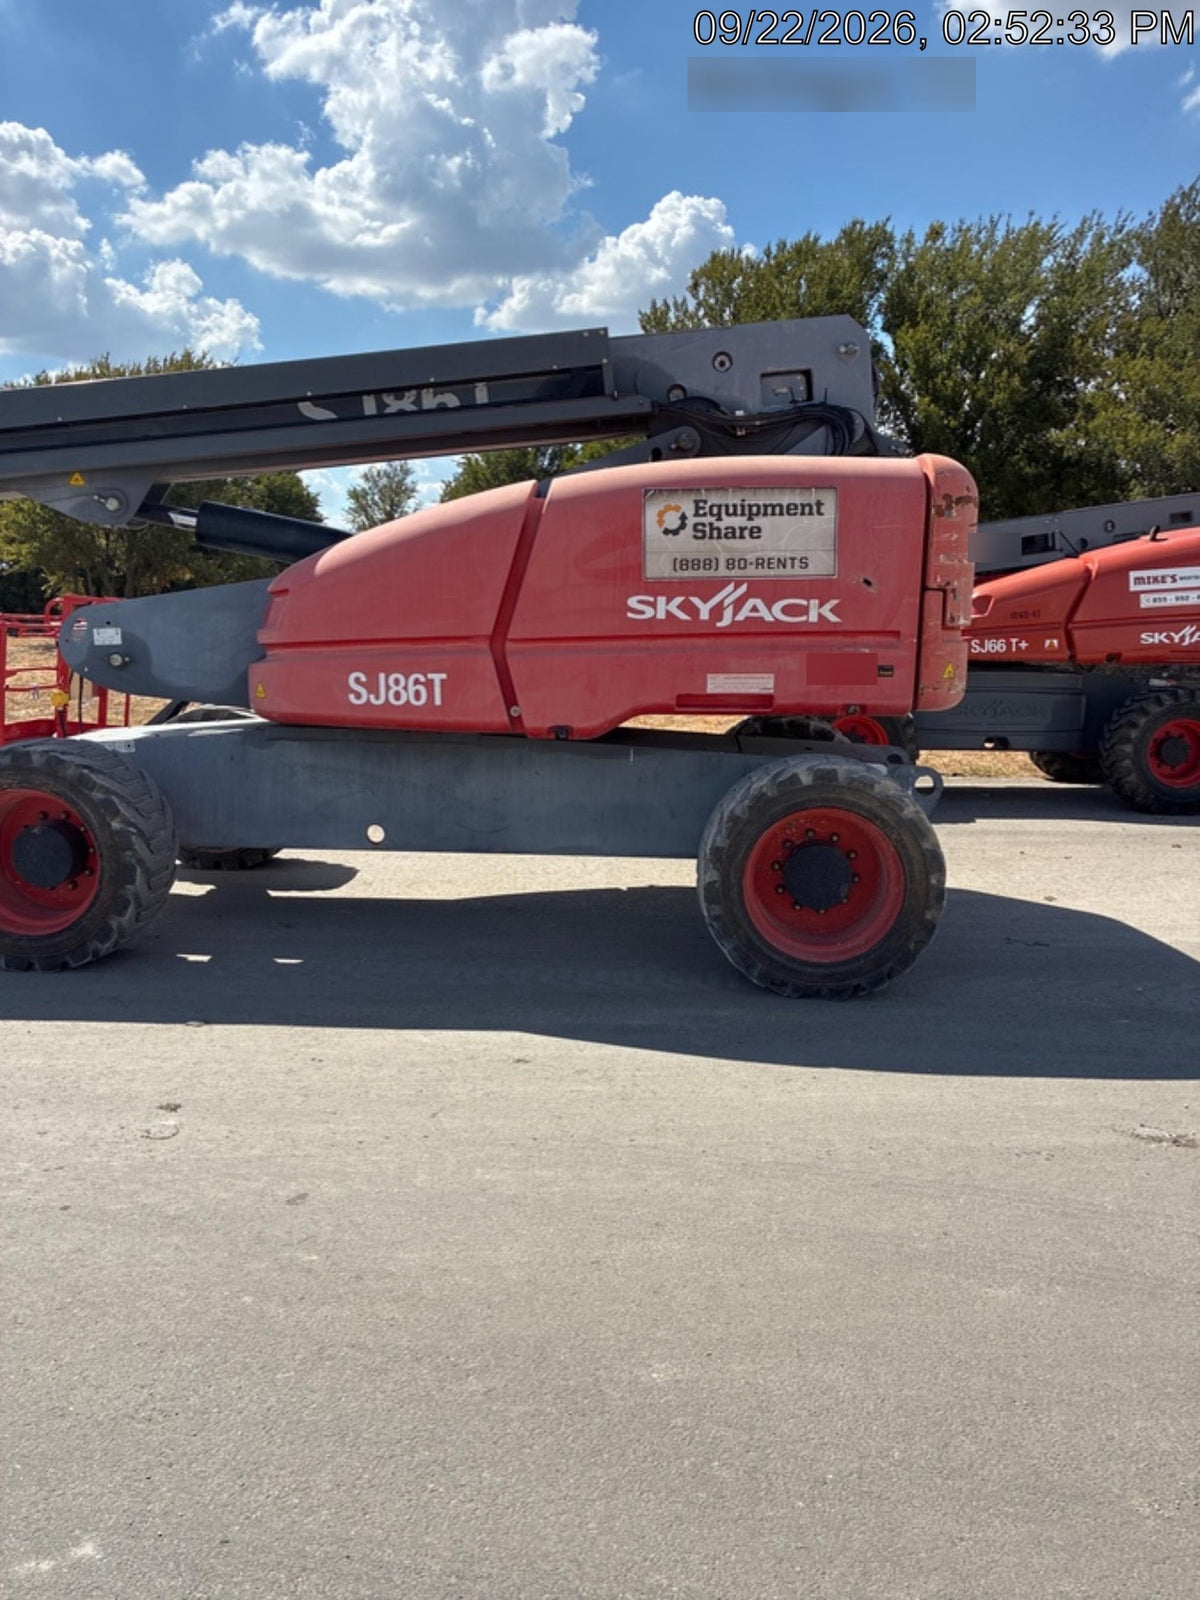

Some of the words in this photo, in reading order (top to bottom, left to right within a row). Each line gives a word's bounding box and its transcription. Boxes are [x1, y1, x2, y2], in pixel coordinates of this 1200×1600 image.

[692, 497, 825, 522] Equipment
[692, 521, 762, 541] Share
[672, 556, 719, 573] (888)
[726, 556, 810, 572] 80-RENTS
[626, 581, 843, 628] SKYJACK
[970, 638, 1007, 653] SJ66
[1009, 637, 1029, 652] T+
[347, 671, 448, 706] SJ86T
